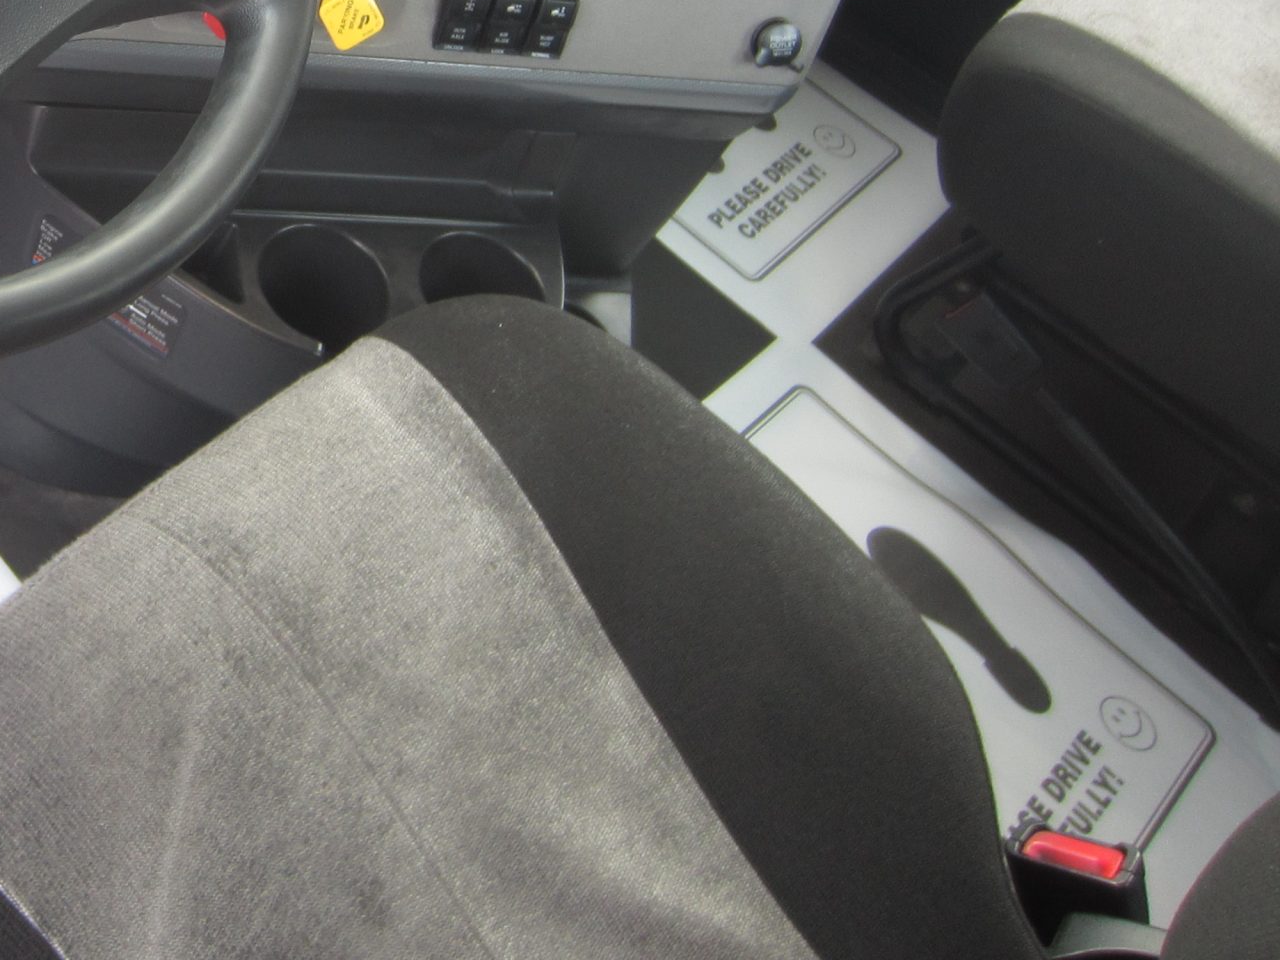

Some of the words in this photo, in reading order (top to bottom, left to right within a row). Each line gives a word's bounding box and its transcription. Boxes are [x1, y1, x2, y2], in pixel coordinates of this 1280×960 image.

[706, 176, 770, 229] PLEASE
[762, 141, 813, 184] DRIVE
[737, 163, 827, 238] CAREFULLY!
[1040, 729, 1103, 803] DRIVE
